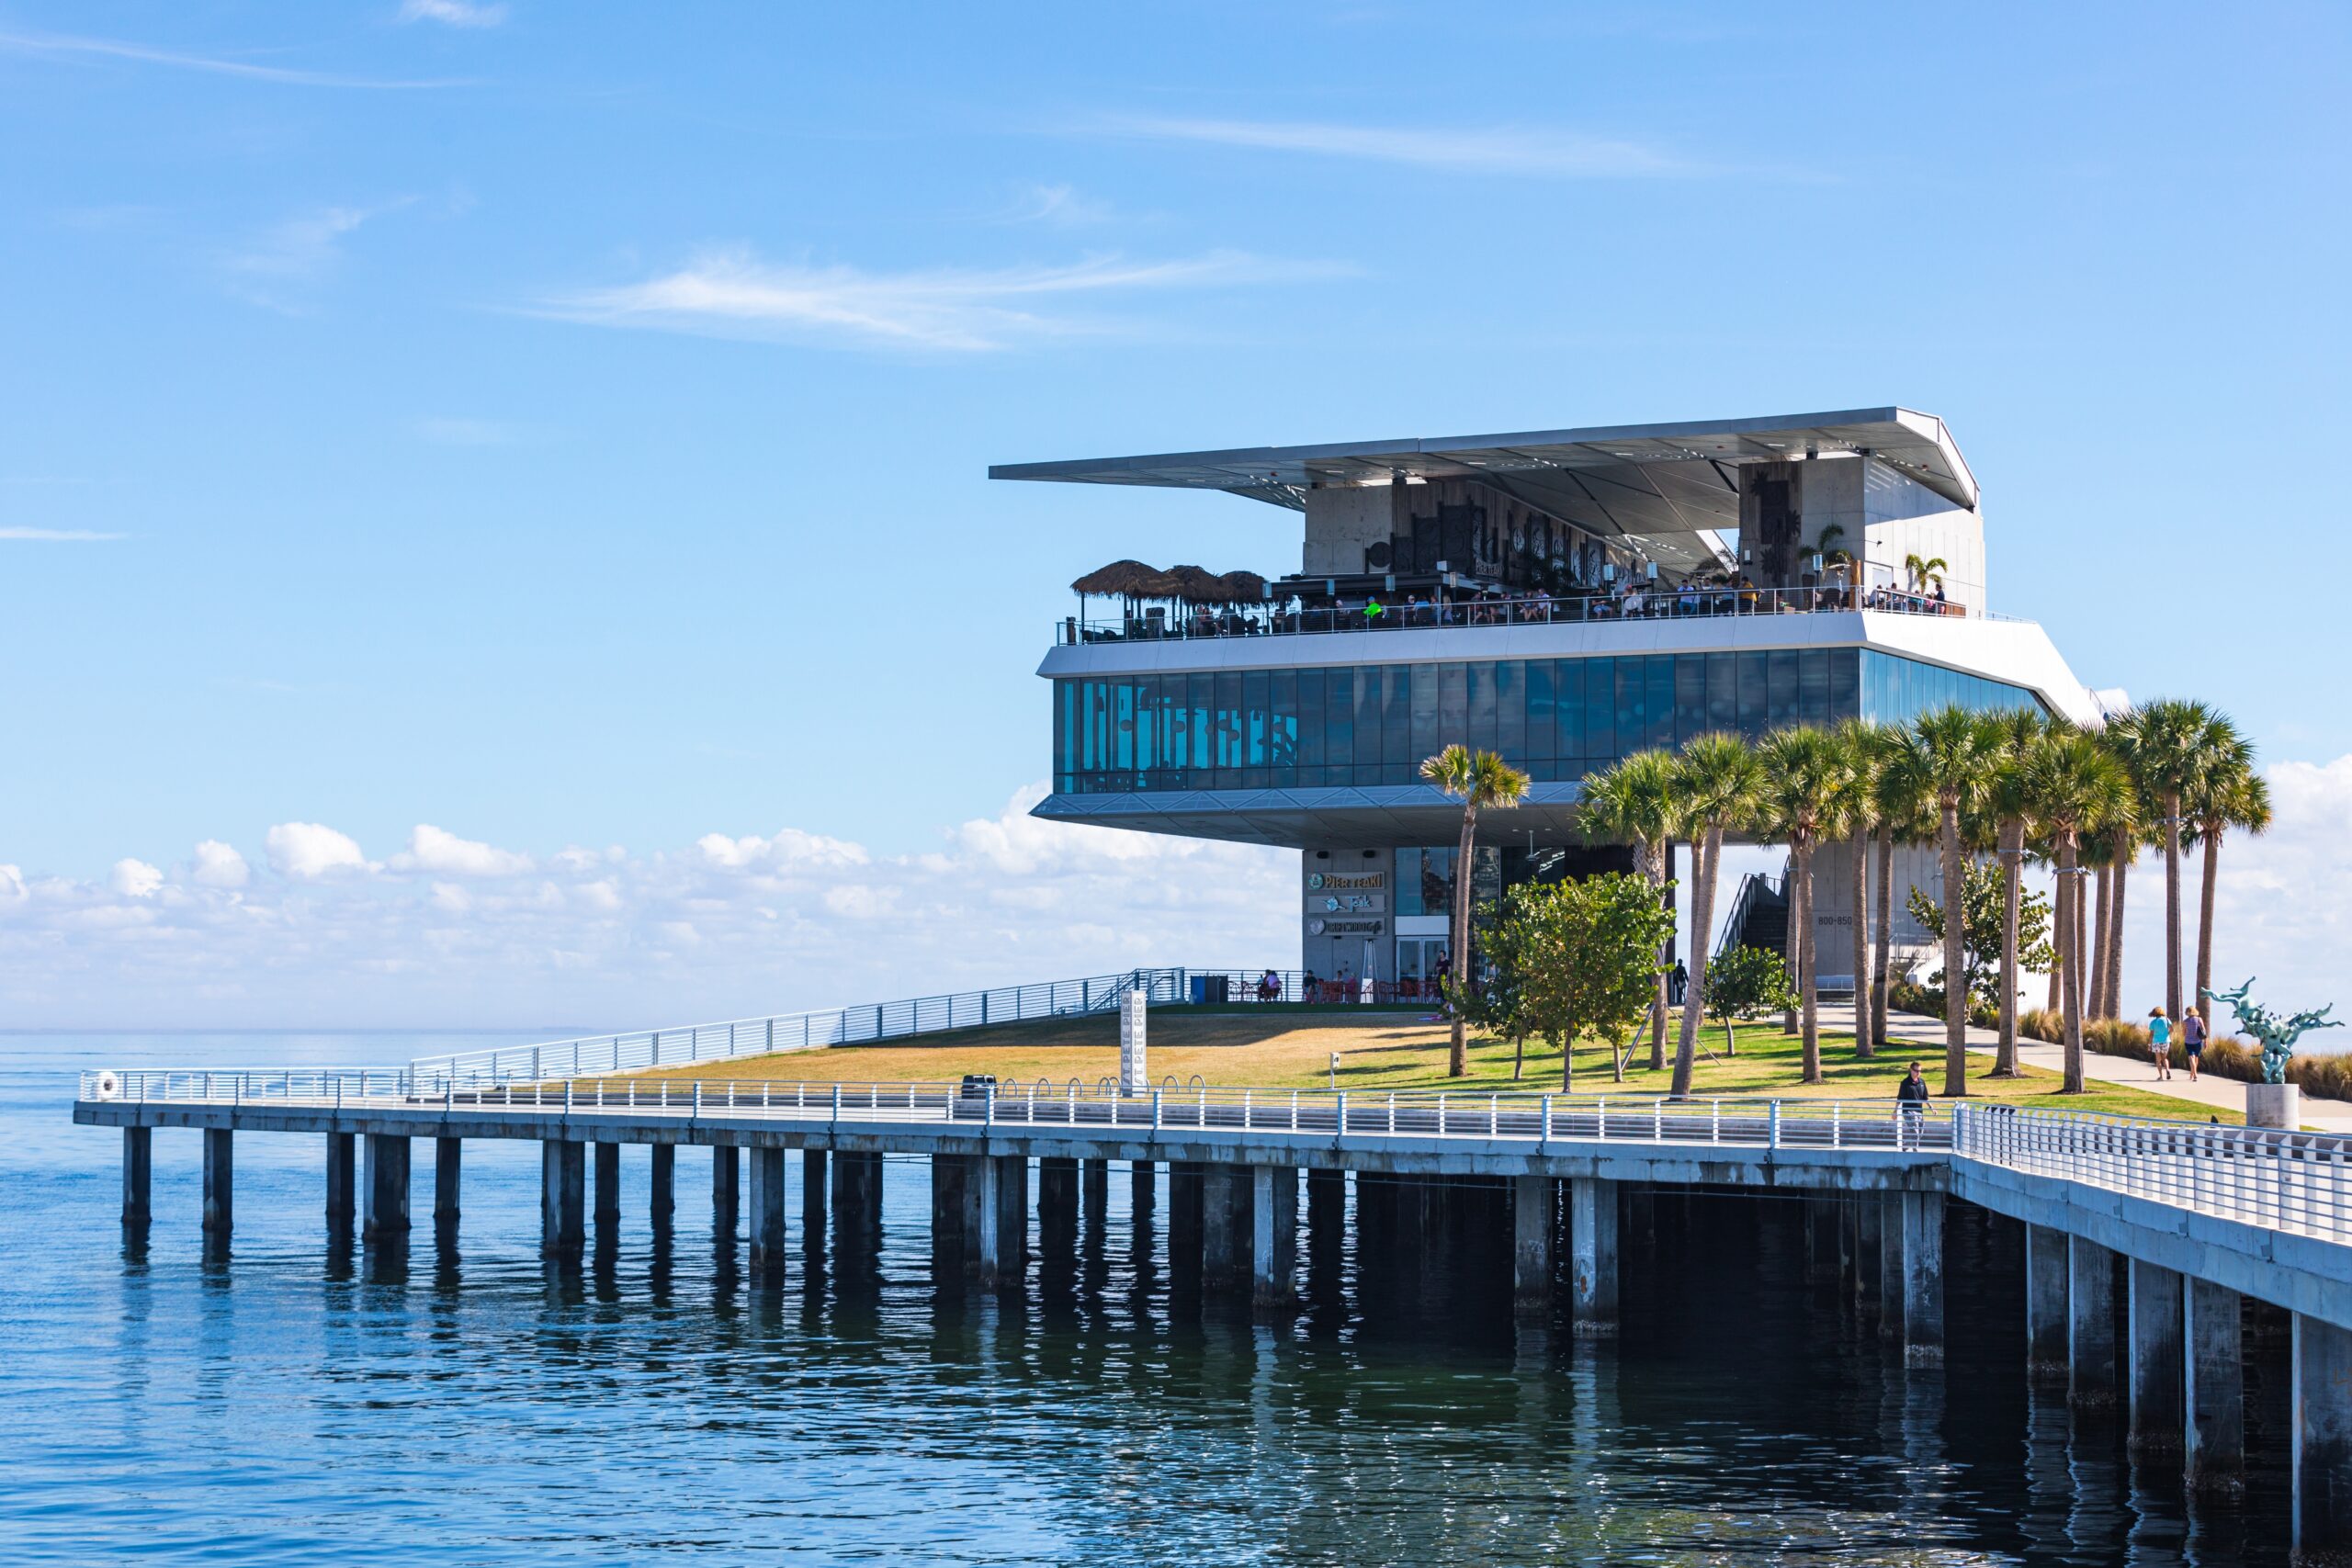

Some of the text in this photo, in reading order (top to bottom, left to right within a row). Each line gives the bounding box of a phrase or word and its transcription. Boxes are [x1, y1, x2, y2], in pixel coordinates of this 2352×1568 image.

[1325, 874, 1382, 888] PIER TEAKI
[1345, 895, 1371, 912] Teak
[1818, 916, 1852, 925] 800-850
[1134, 998, 1143, 1026] PIER
[1134, 1031, 1143, 1064] PETE
